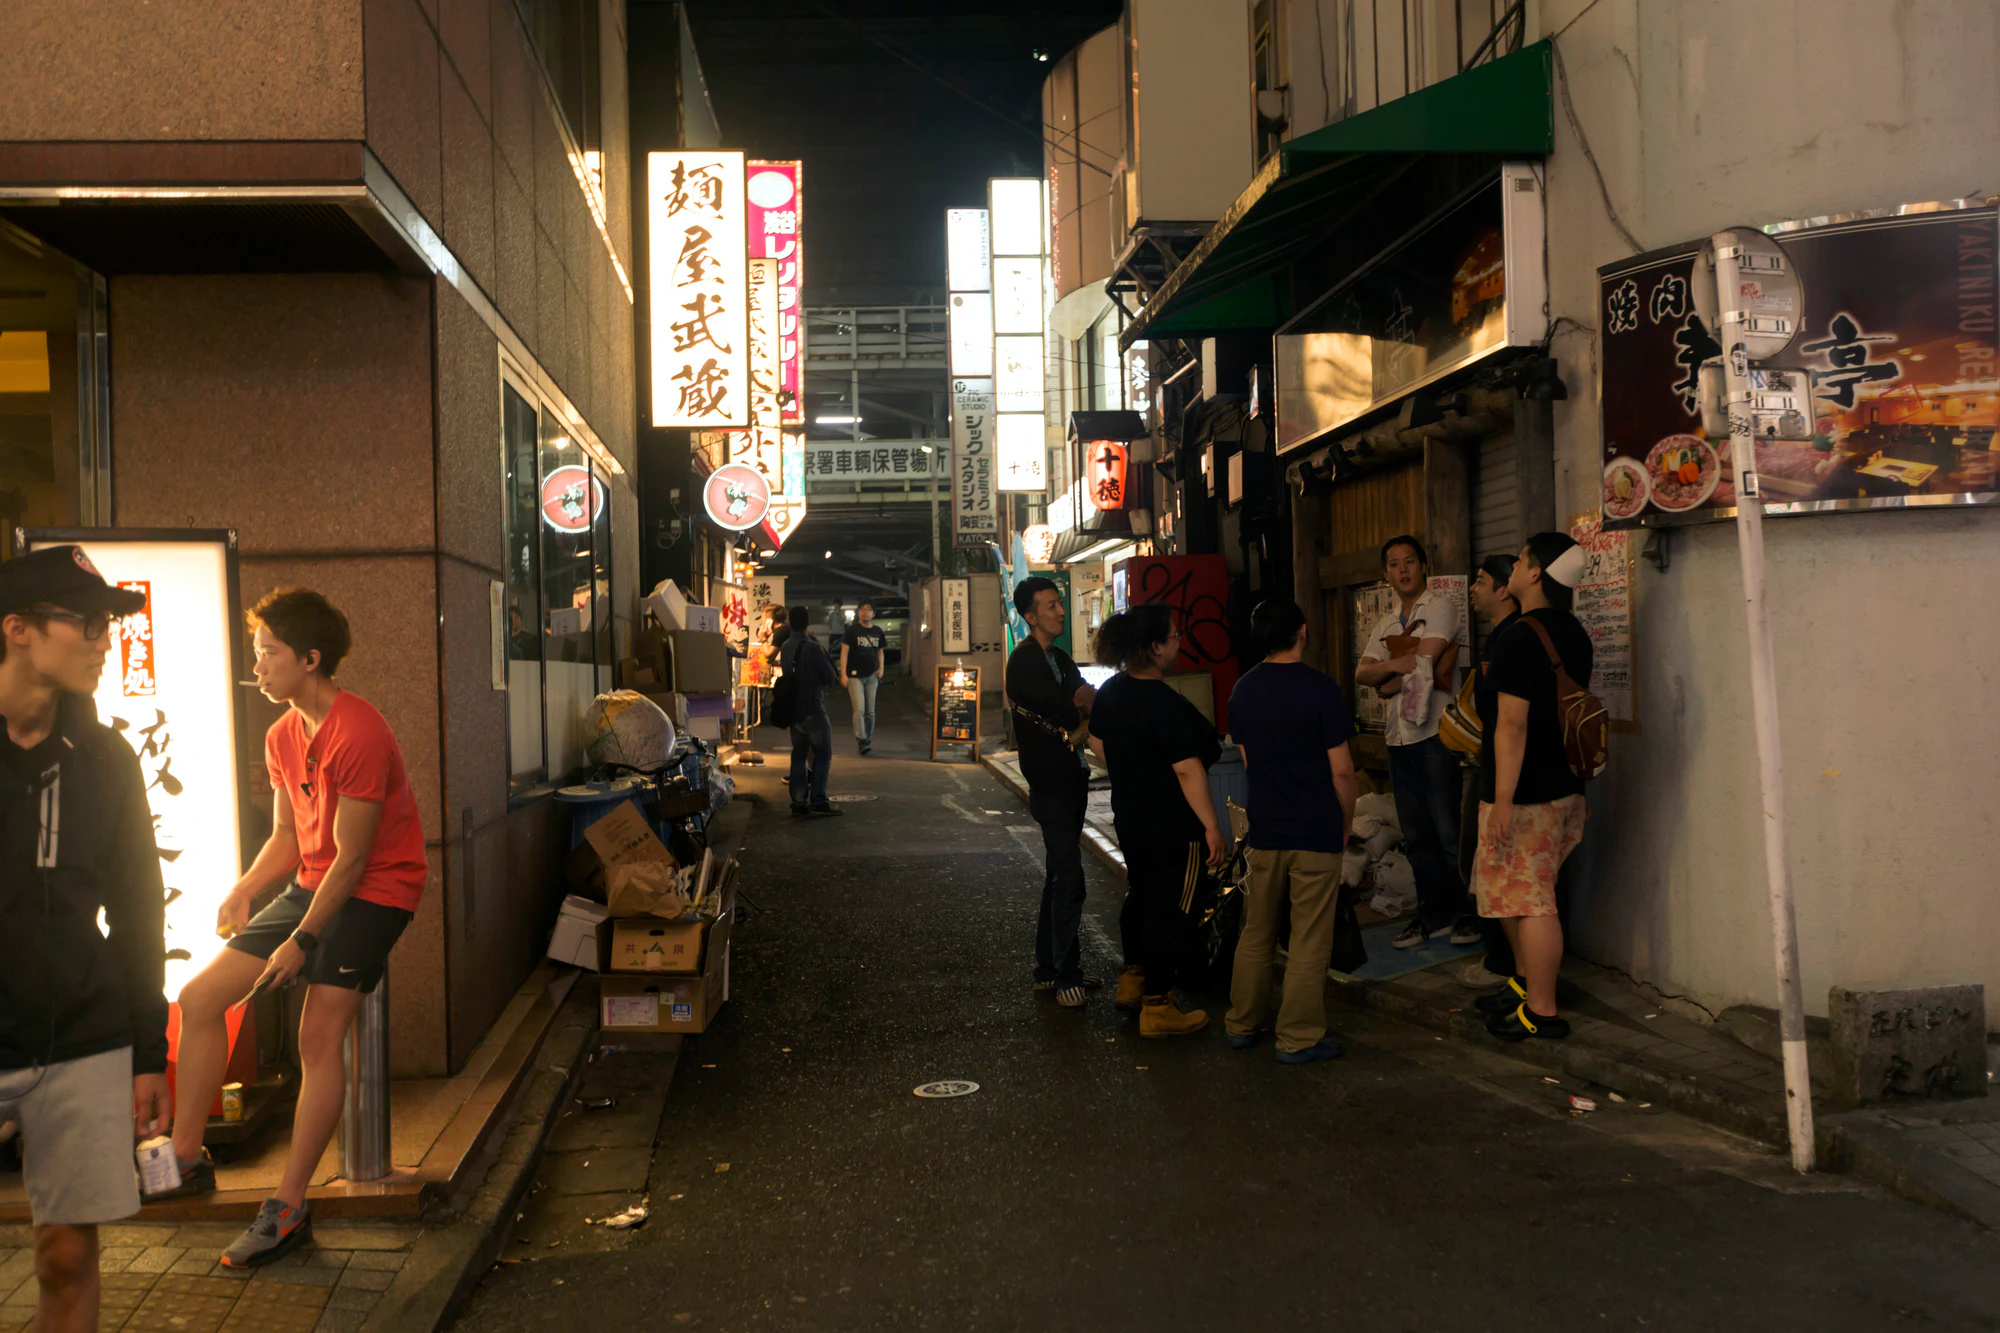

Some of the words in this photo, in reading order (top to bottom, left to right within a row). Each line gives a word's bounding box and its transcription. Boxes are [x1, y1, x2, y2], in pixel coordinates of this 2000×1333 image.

[664, 160, 733, 420] 麺屋武蔵
[1608, 274, 1686, 334] 焼肉
[1958, 221, 1994, 332] YAKINIKU
[962, 457, 975, 511] スタジオ
[1096, 447, 1122, 502] 十徳
